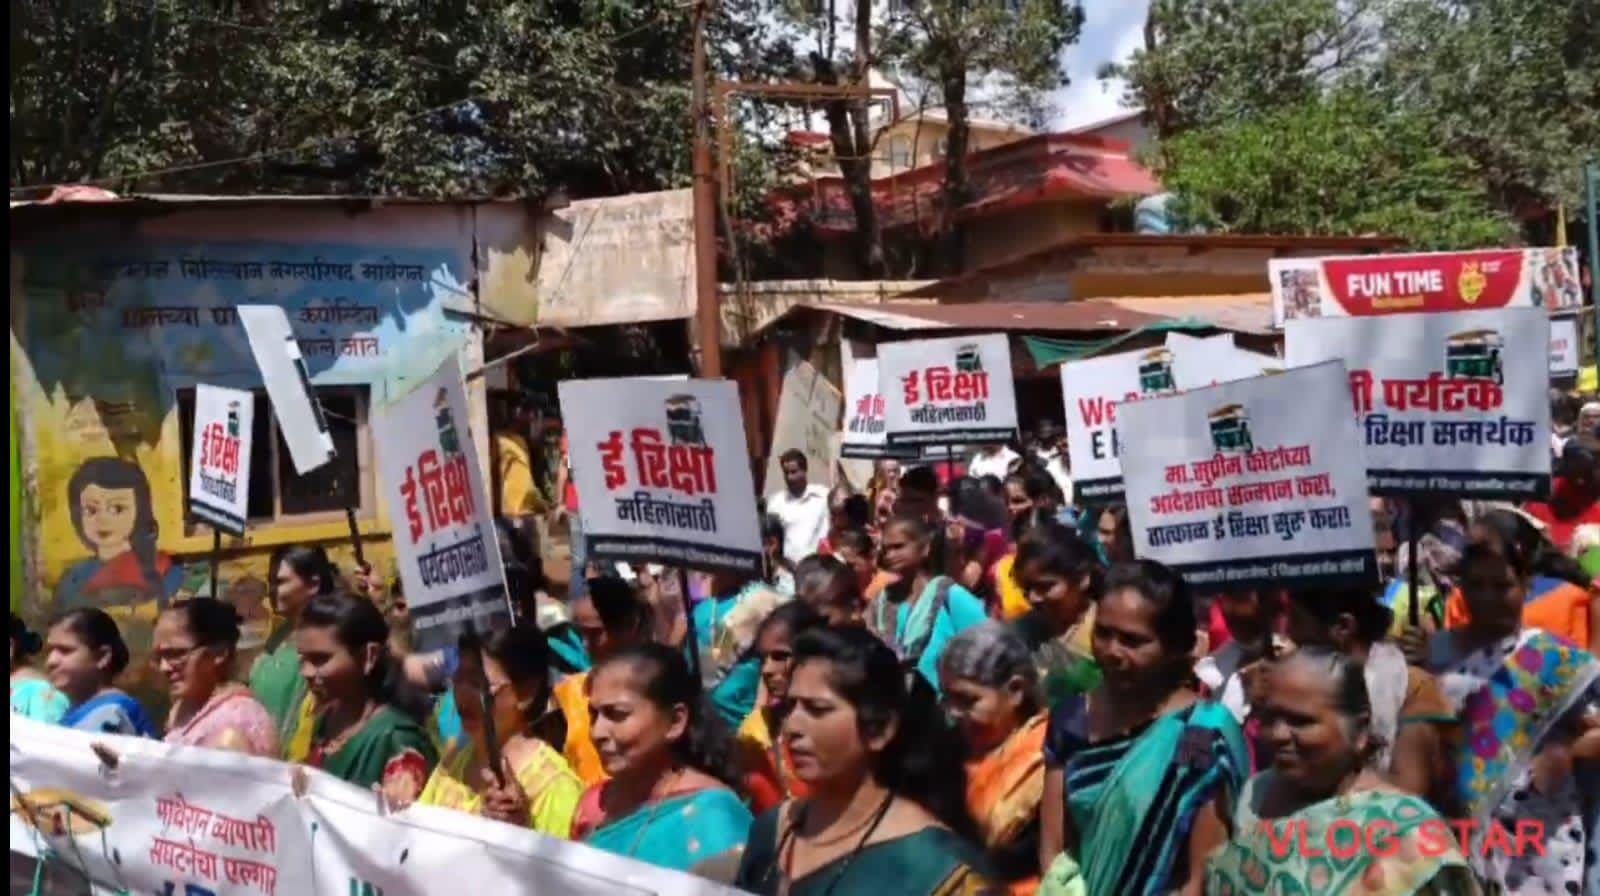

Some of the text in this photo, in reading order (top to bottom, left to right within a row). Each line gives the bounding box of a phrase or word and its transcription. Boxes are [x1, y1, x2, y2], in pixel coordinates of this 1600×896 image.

[1346, 271, 1391, 297] FUN
[1394, 269, 1444, 294] TIME
[903, 370, 919, 405] ई
[926, 366, 988, 401] रिक्षा
[1382, 371, 1504, 412] पर्यटक
[1079, 397, 1116, 427] We
[1365, 414, 1536, 447] रिक्षा समर्थक
[202, 421, 241, 475] ई रिक्षा
[597, 427, 716, 494] ई रिक्षा
[1091, 431, 1105, 459] E
[400, 449, 475, 545] ई रिक्षा
[615, 491, 717, 533] महिलांसाठी
[1151, 487, 1224, 514] आदेशाचा
[1227, 479, 1293, 506] सन्मान
[1297, 472, 1336, 497] करा,
[1214, 513, 1225, 540] ई
[1228, 511, 1269, 537] रिक्षा
[1310, 505, 1351, 530] करा!
[211, 813, 276, 853] व्यापारी
